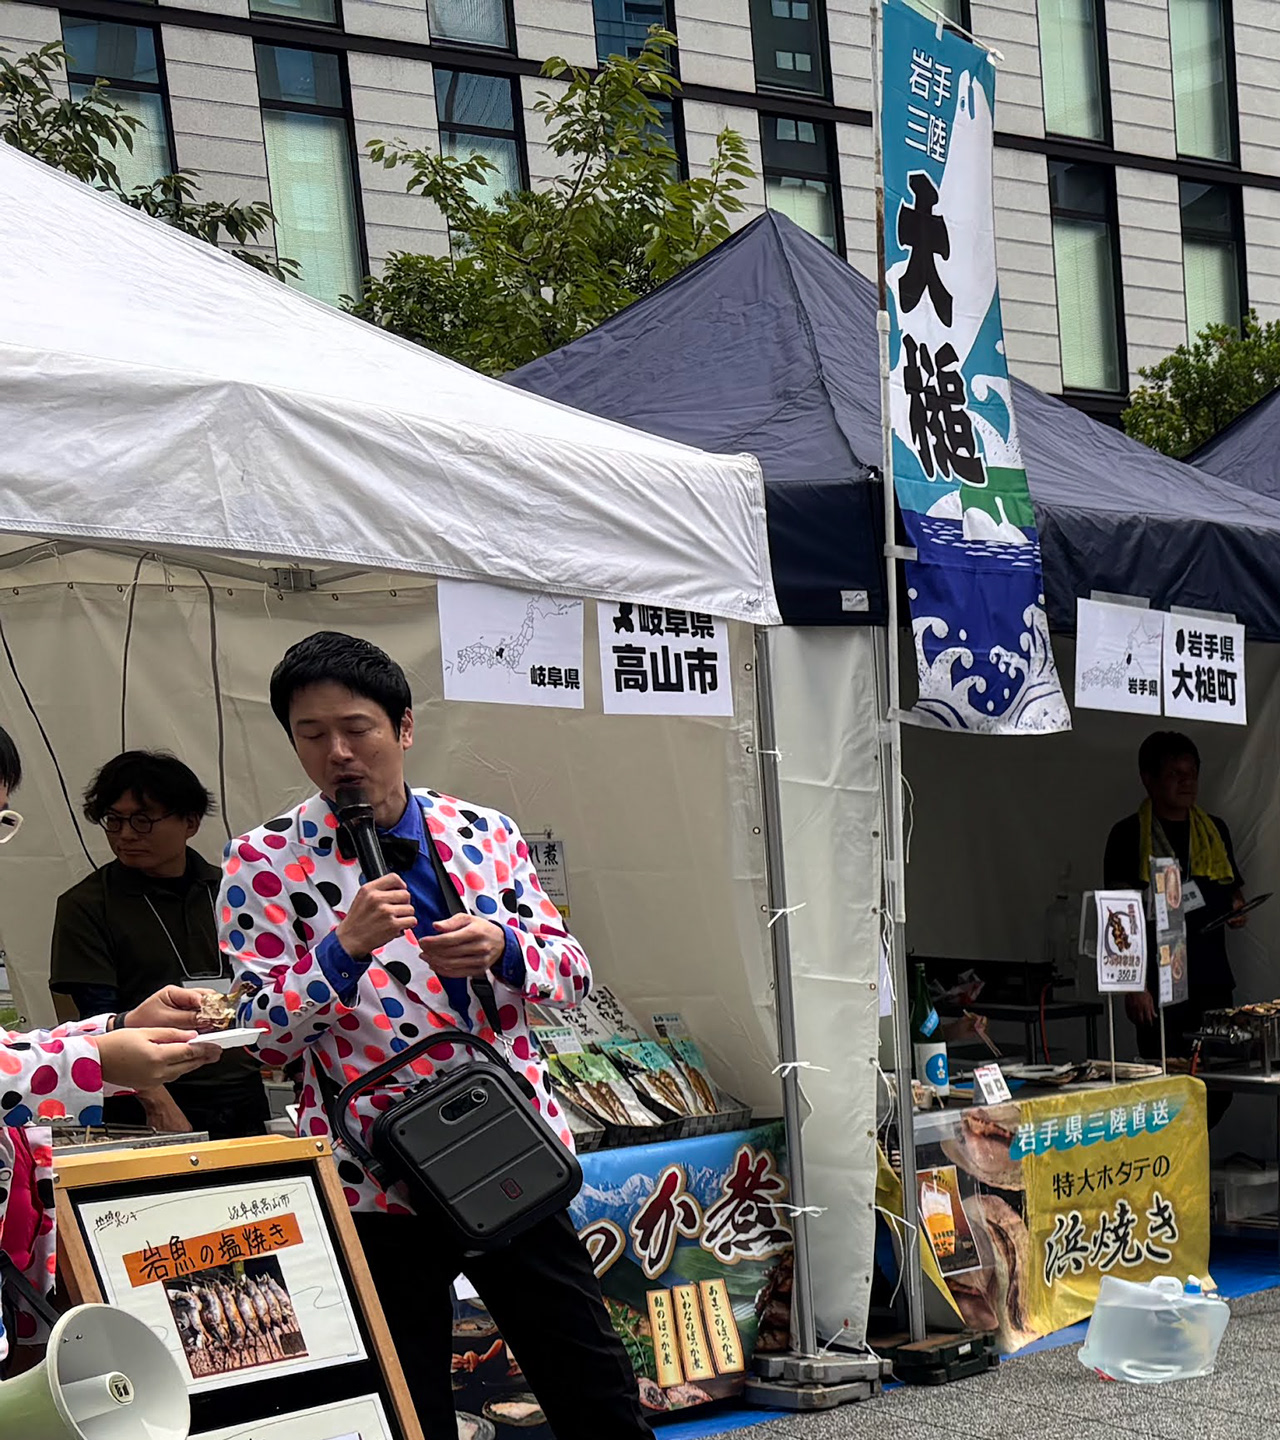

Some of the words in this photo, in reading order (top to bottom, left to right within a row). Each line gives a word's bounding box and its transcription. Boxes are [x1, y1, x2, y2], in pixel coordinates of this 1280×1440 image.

[909, 49, 952, 106] 岩手
[905, 111, 948, 165] 三陸
[897, 173, 988, 486] 大槌
[639, 603, 715, 639] 岐阜県
[612, 644, 718, 694] 高山市
[1187, 630, 1235, 663] 岩手県
[530, 664, 580, 690] 岐阜県
[1128, 677, 1158, 697] 岩手県
[1171, 663, 1238, 706] 大槌町
[1018, 1099, 1169, 1152] 岩手県三陸直送
[1053, 1155, 1170, 1199] 特大ホタテの
[228, 1194, 290, 1221] 岐阜県高山市
[140, 1224, 289, 1280] 岩魚の塩焼き
[1045, 1193, 1178, 1286] 浜焼き
